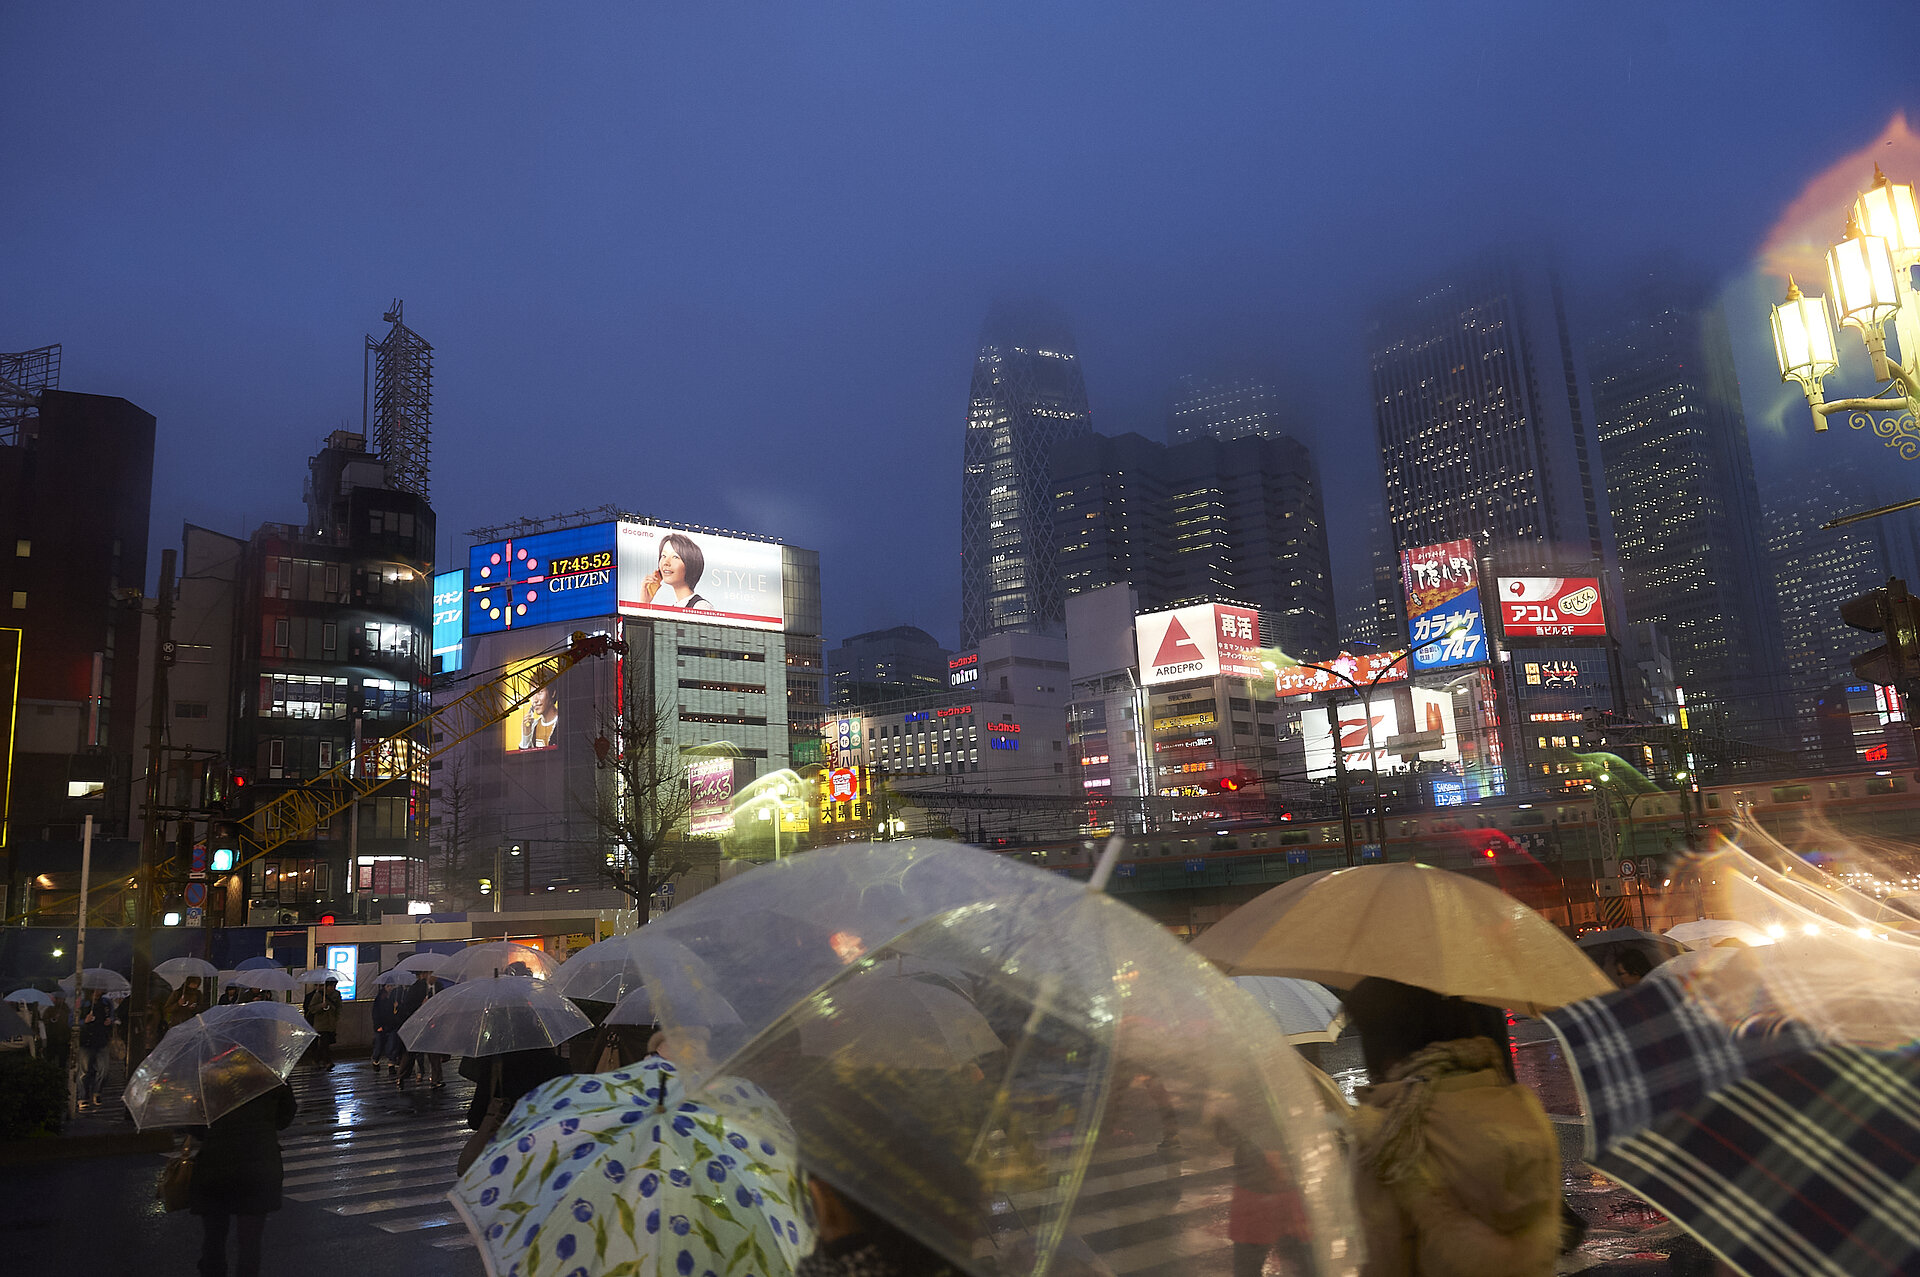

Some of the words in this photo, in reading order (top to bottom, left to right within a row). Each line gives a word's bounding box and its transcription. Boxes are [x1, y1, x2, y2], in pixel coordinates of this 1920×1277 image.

[622, 527, 654, 538] docomo
[549, 569, 611, 593] CITIZEN
[711, 568, 767, 593] STYLE
[1412, 557, 1473, 590] 隠れ野
[1562, 592, 1594, 611] むじんくん
[1510, 605, 1558, 622] アコム
[1220, 613, 1253, 641] 再活
[1413, 609, 1479, 642] カラオケ
[1440, 634, 1481, 662] 747
[951, 668, 978, 686] ODAKYU
[1155, 661, 1203, 677] ARDEPRO
[364, 699, 376, 707] 5F
[905, 711, 930, 723] ODAKYU
[1199, 714, 1209, 723] 8F
[991, 736, 1019, 751] ODAKYU
[832, 773, 852, 797] 買
[335, 951, 349, 970] P
